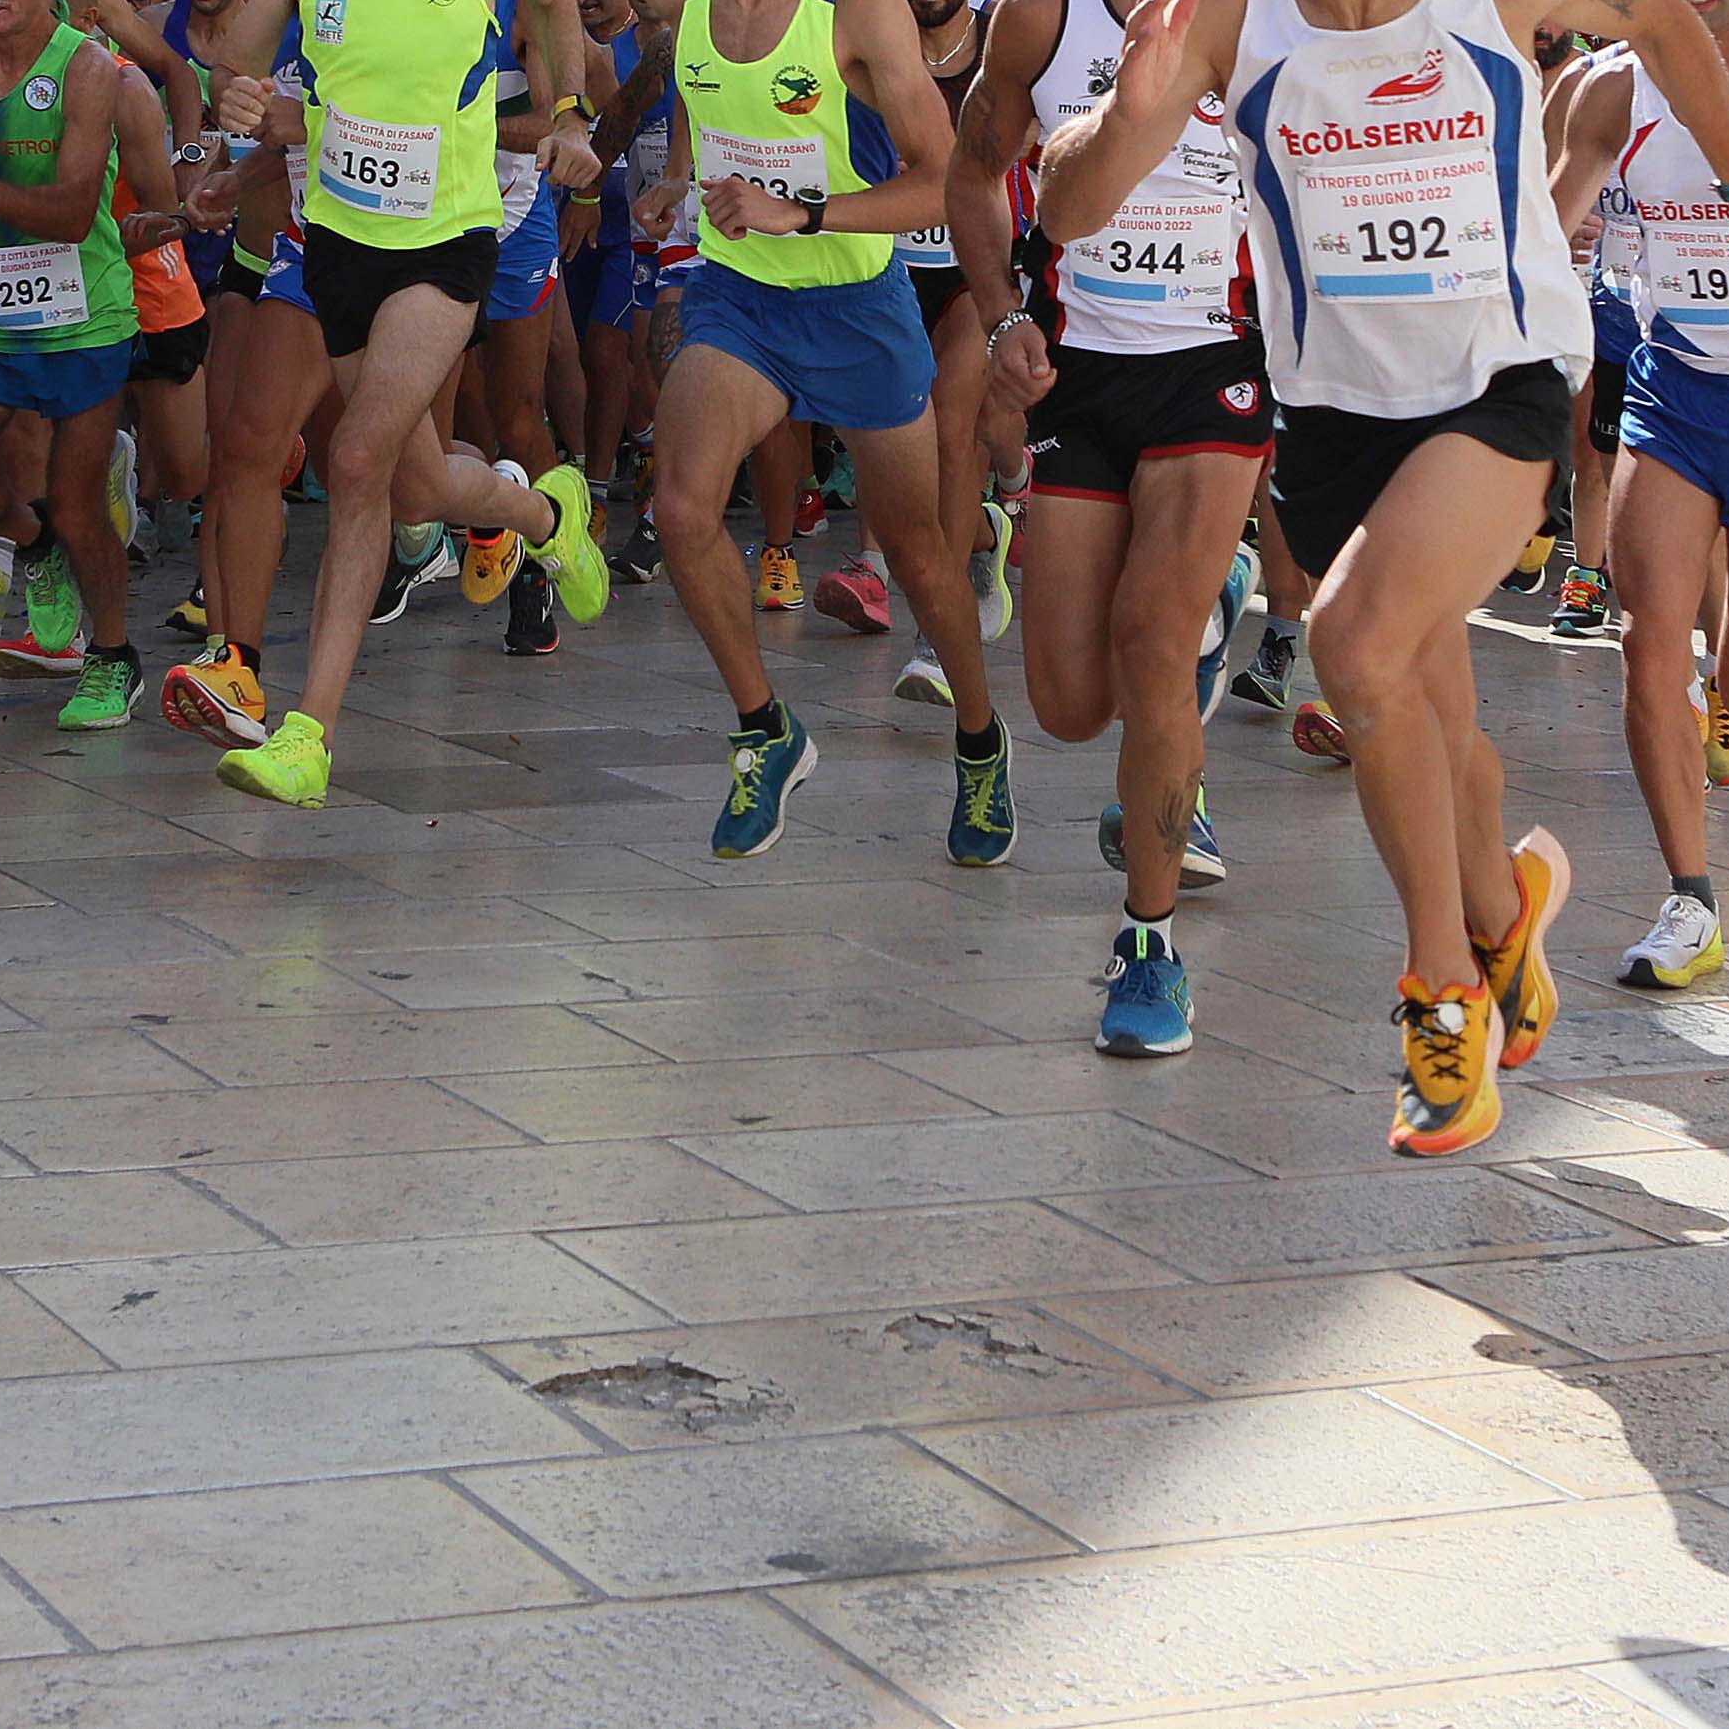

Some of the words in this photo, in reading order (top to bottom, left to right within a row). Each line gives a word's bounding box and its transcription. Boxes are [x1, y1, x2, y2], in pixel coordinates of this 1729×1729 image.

[1058, 103, 1091, 114] mon
[360, 125, 385, 137] CITTÀ
[387, 130, 397, 139] DI
[399, 130, 434, 141] FASANO
[350, 134, 383, 149] GIUGNO
[385, 142, 408, 152] 2022
[741, 142, 763, 154] CITTÀ
[765, 145, 775, 155] DI
[777, 143, 816, 156] FASANO
[341, 150, 400, 189] 163
[767, 159, 791, 168] 2022
[1306, 179, 1317, 190] XI
[1320, 176, 1372, 190] TROFEO
[1375, 169, 1413, 186] CITTÀ
[1416, 170, 1429, 182] DI
[1433, 161, 1486, 180] FASANO
[1342, 195, 1358, 207] 19
[1362, 190, 1414, 206] GIUGNO
[1418, 186, 1452, 202] 2022
[1132, 204, 1162, 215] CITTÀ
[1165, 205, 1176, 215] DI
[1179, 204, 1223, 215] FASANO
[1119, 220, 1162, 231] GIUGNO
[1164, 221, 1192, 231] 2022
[1357, 216, 1450, 263] 192
[1663, 232, 1696, 244] TROFEO
[1697, 231, 1722, 244] CITTÀ
[8, 250, 29, 261] CITTÀ
[40, 245, 72, 256] FASANO
[1109, 240, 1185, 275] 344
[1689, 248, 1725, 258] GIUGNO
